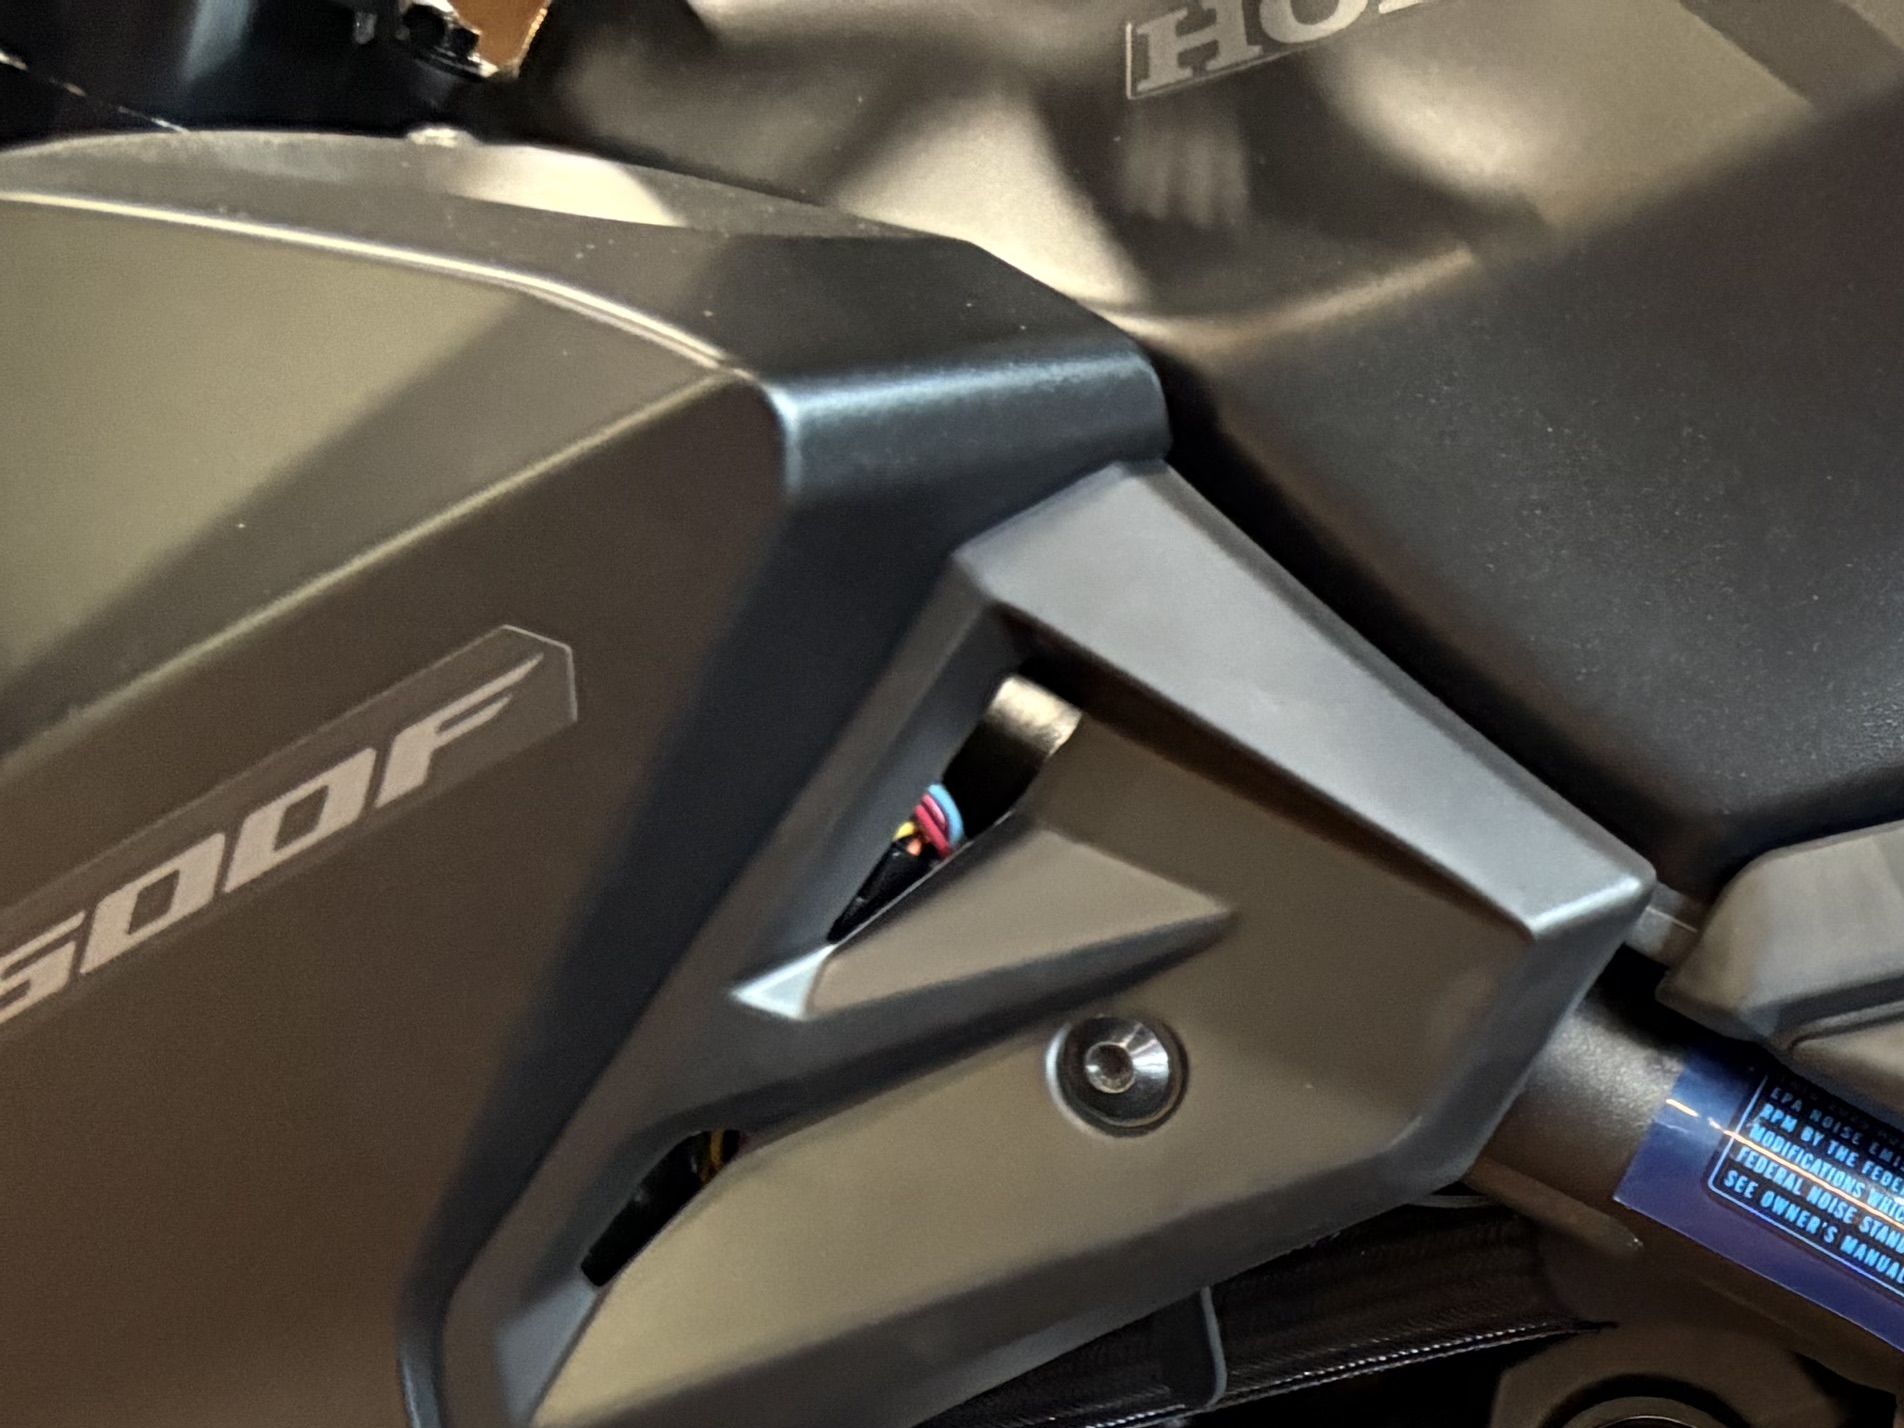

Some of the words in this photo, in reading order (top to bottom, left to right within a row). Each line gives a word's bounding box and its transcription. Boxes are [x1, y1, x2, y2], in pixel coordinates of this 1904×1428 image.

[1745, 1121, 1869, 1201] MODIFICATIONS
[1757, 1103, 1798, 1133] RPM
[1799, 1125, 1824, 1147] BY
[1826, 1139, 1859, 1168] THE
[1808, 1108, 1862, 1146] NOISE
[1723, 1169, 1759, 1199] SEE
[1760, 1190, 1838, 1244] OWNER'S
[1734, 1145, 1804, 1196] FEDERAL
[1805, 1184, 1858, 1224] NOISE
